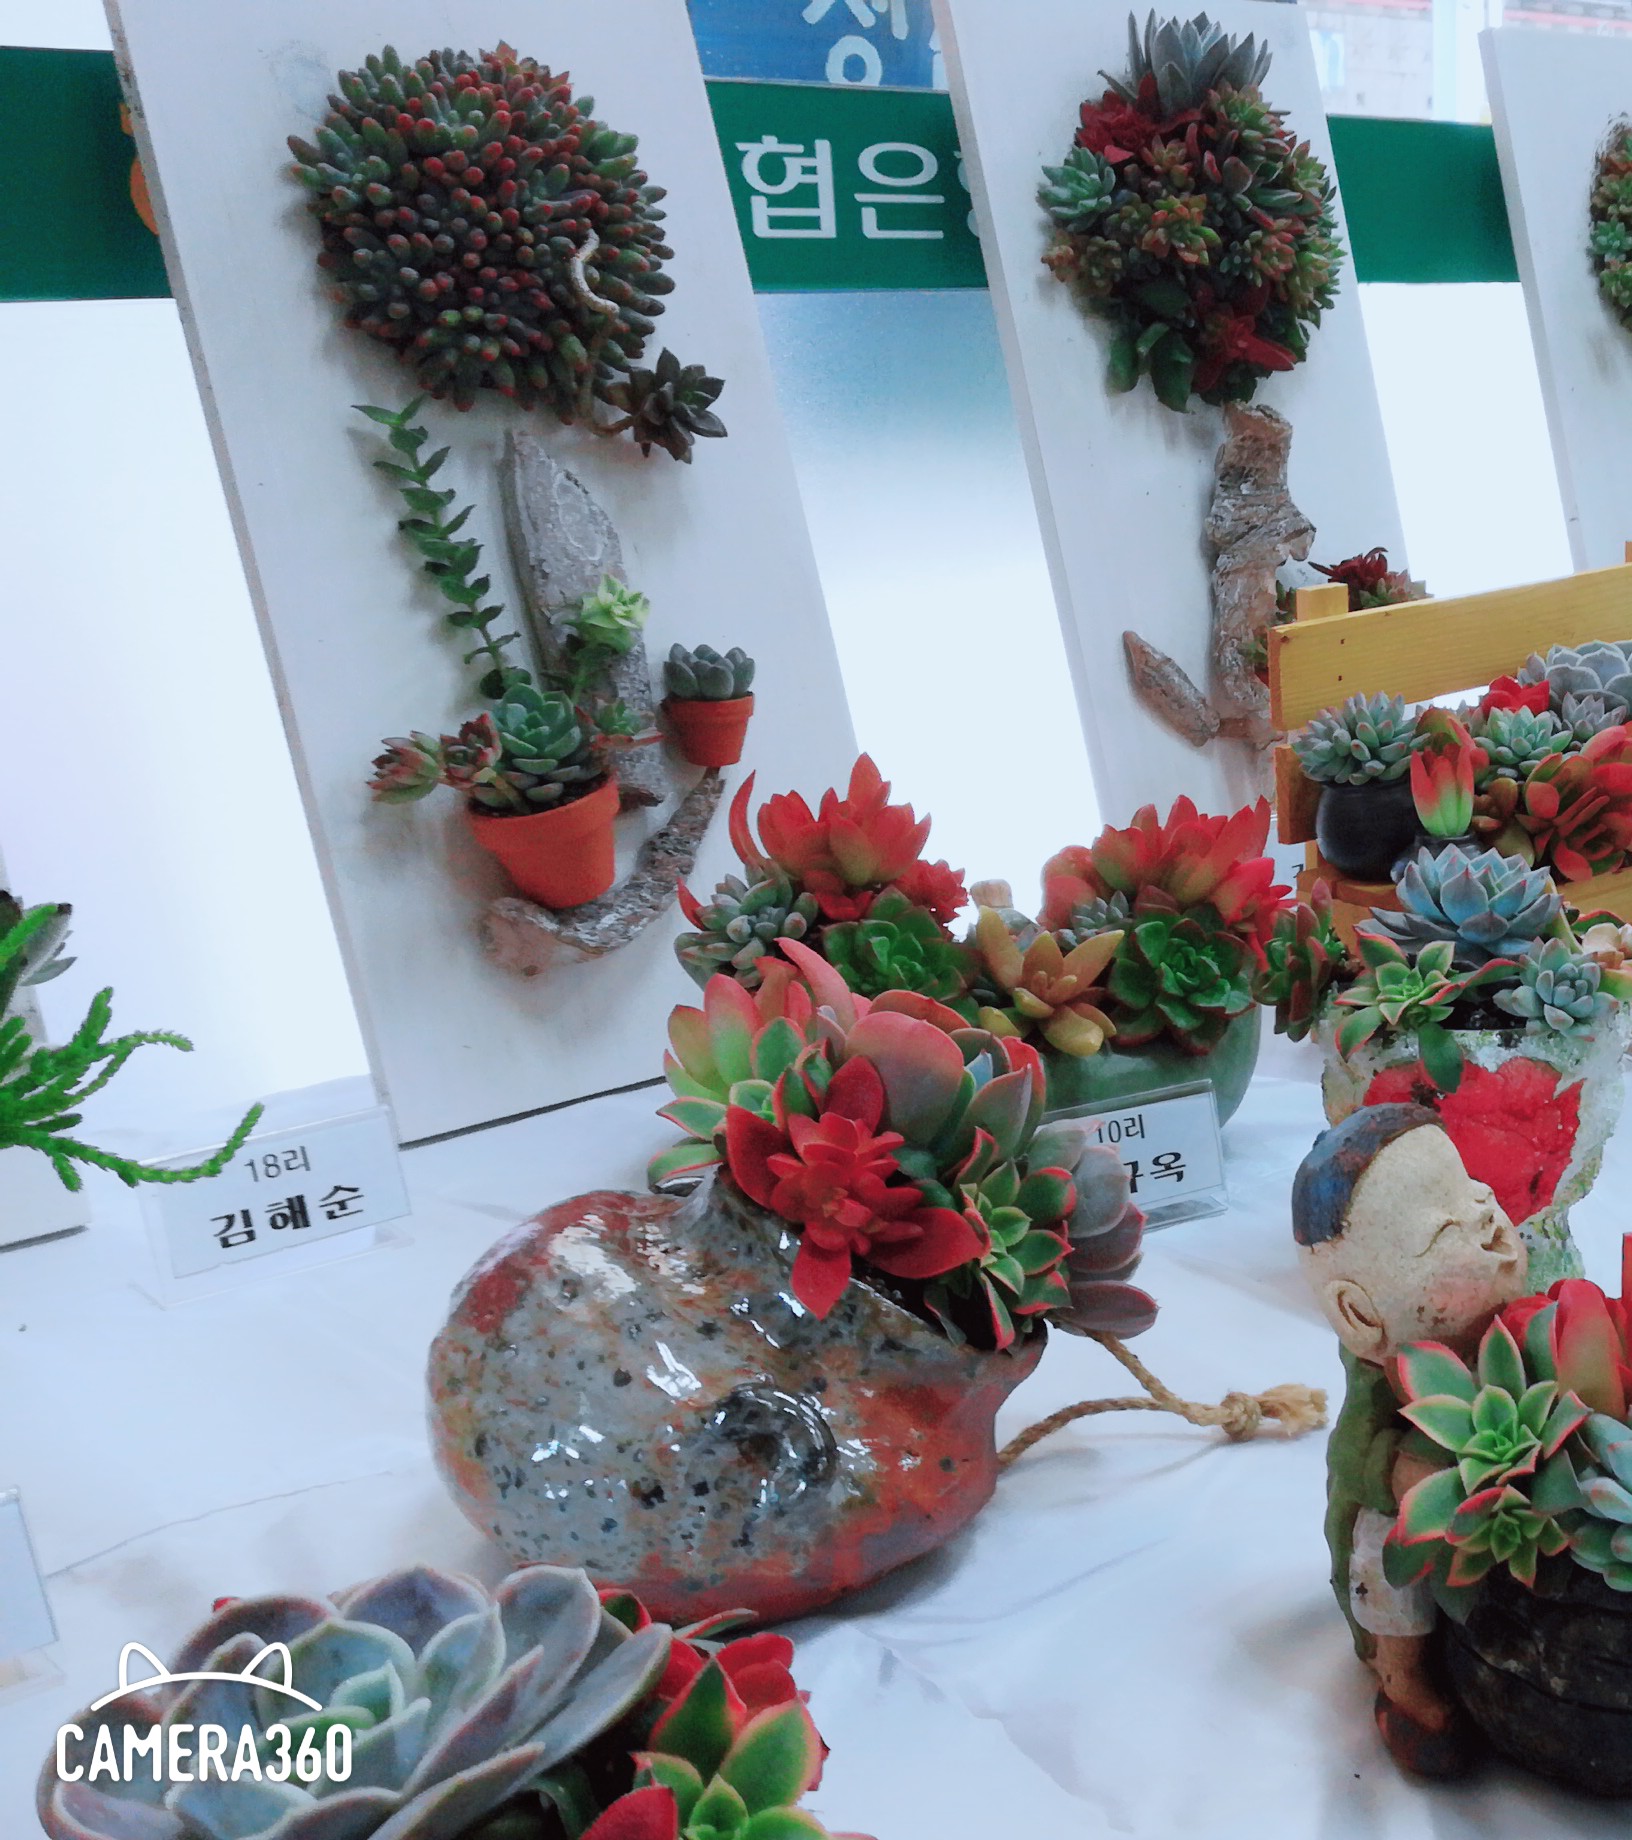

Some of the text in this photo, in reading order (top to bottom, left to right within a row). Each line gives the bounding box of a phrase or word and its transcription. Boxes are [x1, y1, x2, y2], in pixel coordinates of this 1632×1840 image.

[735, 135, 985, 239] 협은
[1097, 1113, 1145, 1143] 10리
[244, 1146, 311, 1182] 18리
[210, 1185, 364, 1248] 김해순
